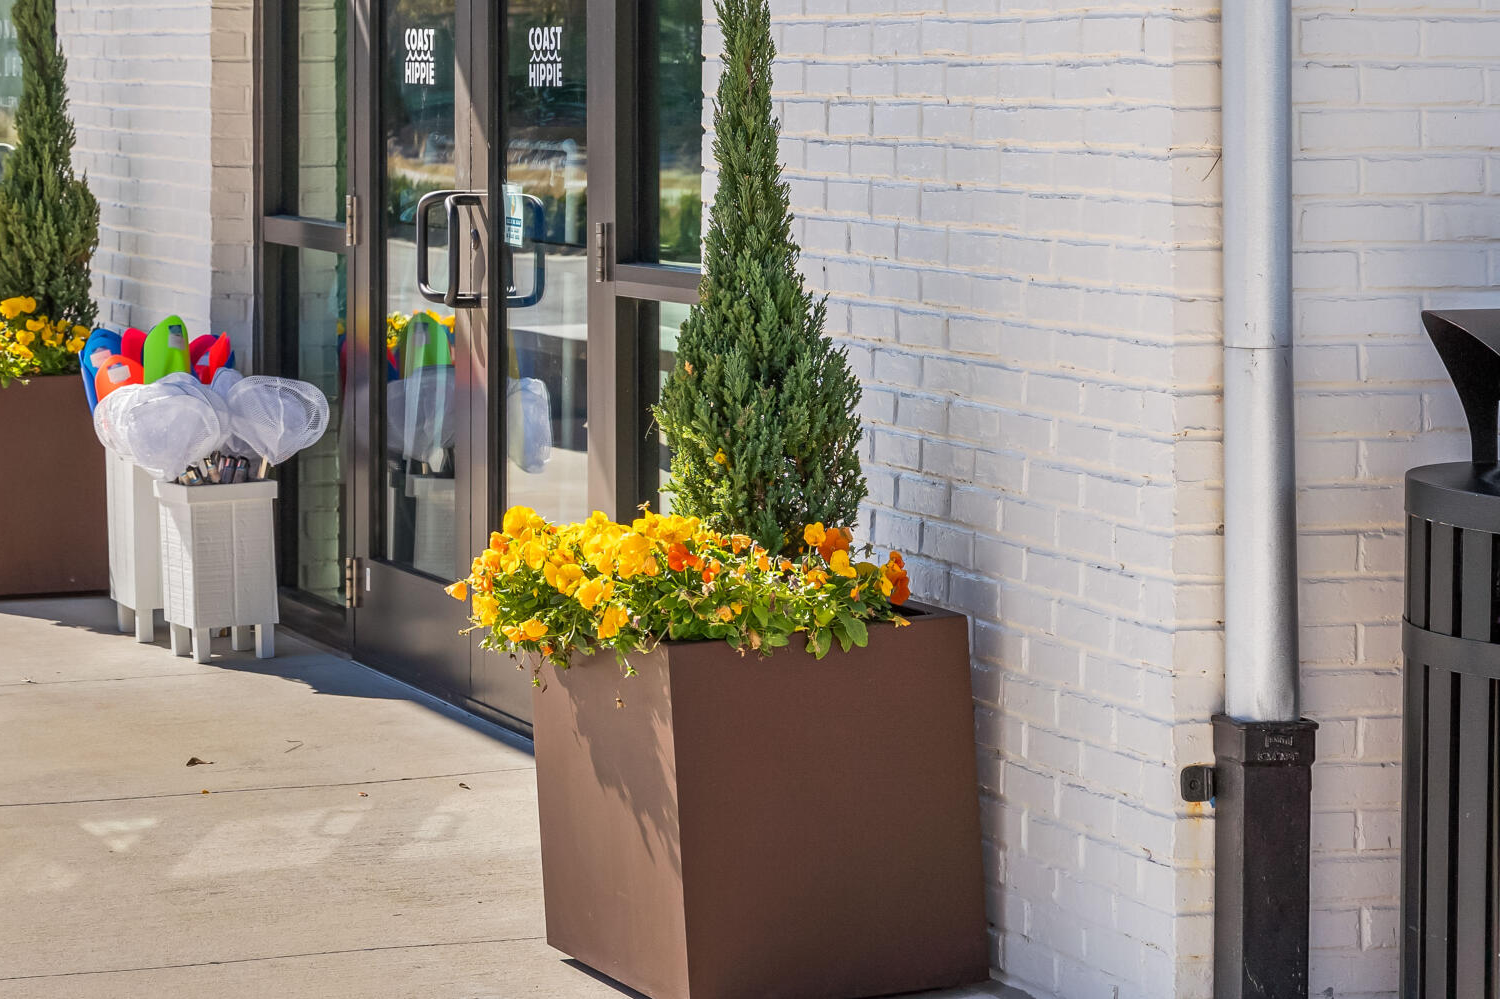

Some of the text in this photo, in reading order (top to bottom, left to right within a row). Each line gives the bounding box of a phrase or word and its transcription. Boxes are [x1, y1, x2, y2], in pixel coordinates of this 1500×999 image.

[405, 28, 435, 51] COAST
[528, 26, 563, 51] COAST
[405, 62, 436, 85] HIPPIE
[528, 63, 563, 87] HIPPIE
